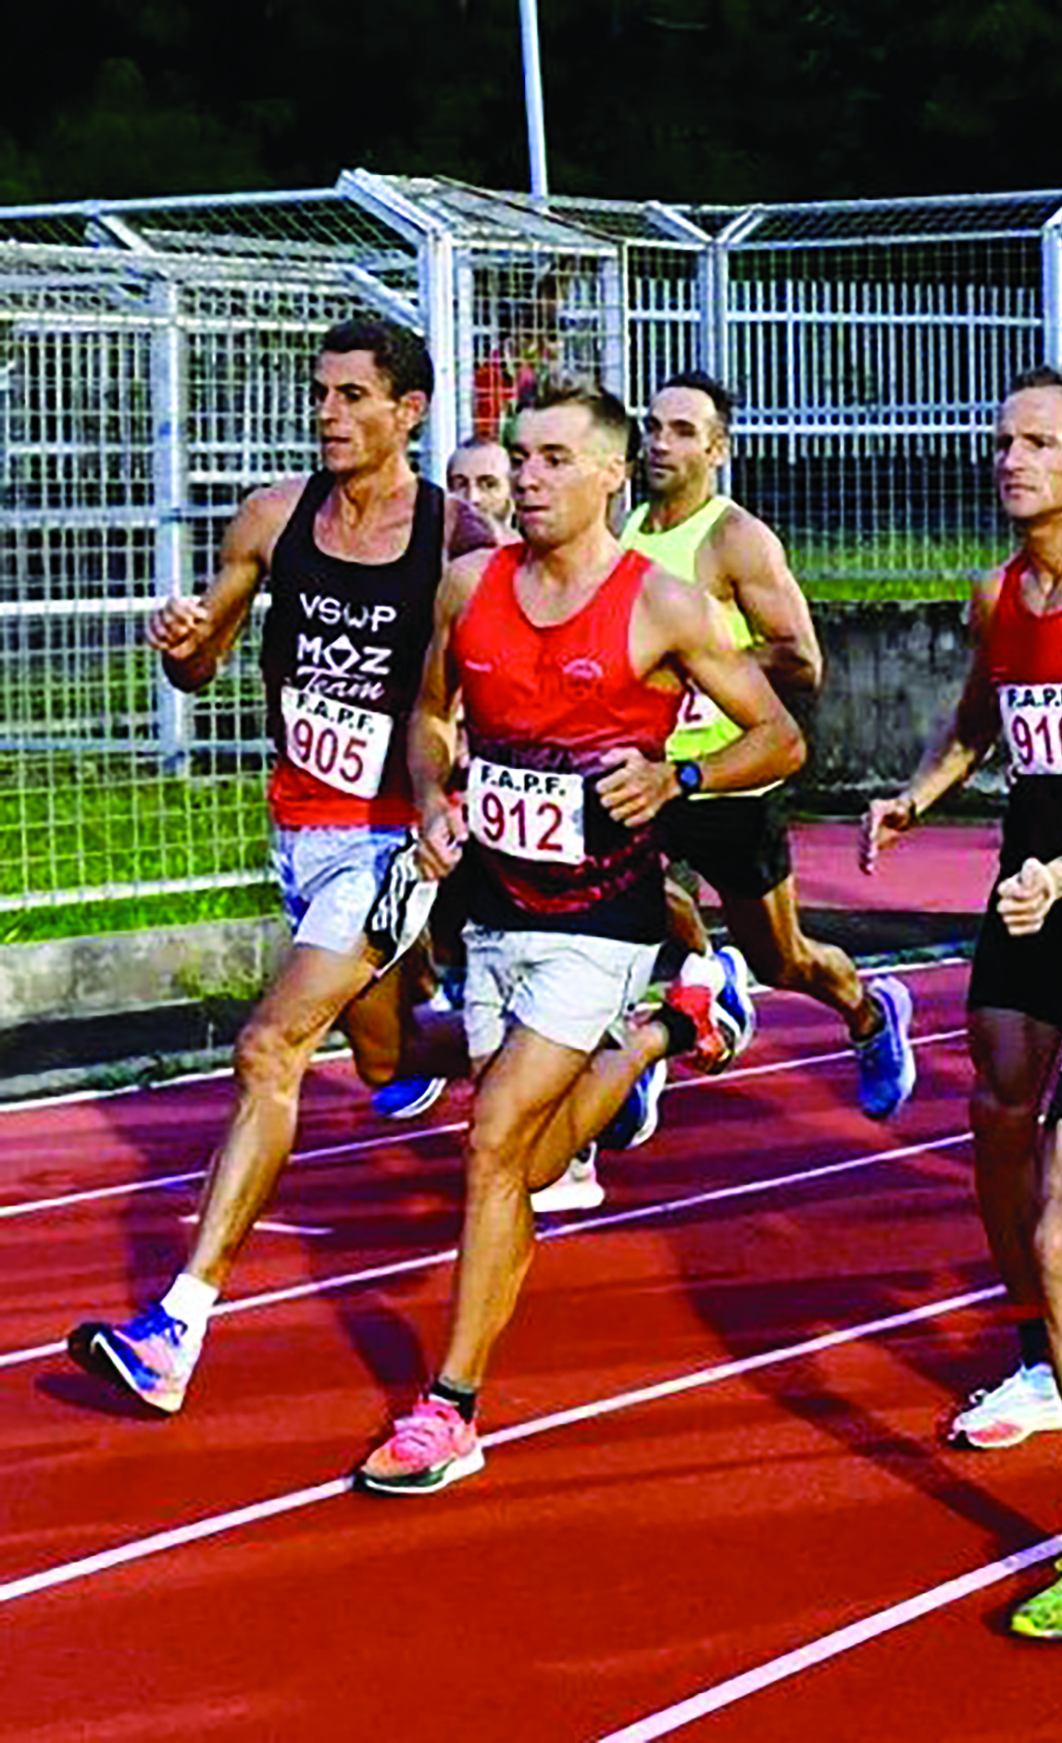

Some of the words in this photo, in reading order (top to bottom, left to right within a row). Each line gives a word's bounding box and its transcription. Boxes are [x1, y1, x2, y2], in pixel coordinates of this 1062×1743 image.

[299, 593, 398, 632] VSWP
[293, 718, 365, 783] 905
[480, 765, 567, 796] F.A.P.F.
[482, 792, 563, 852] 912
